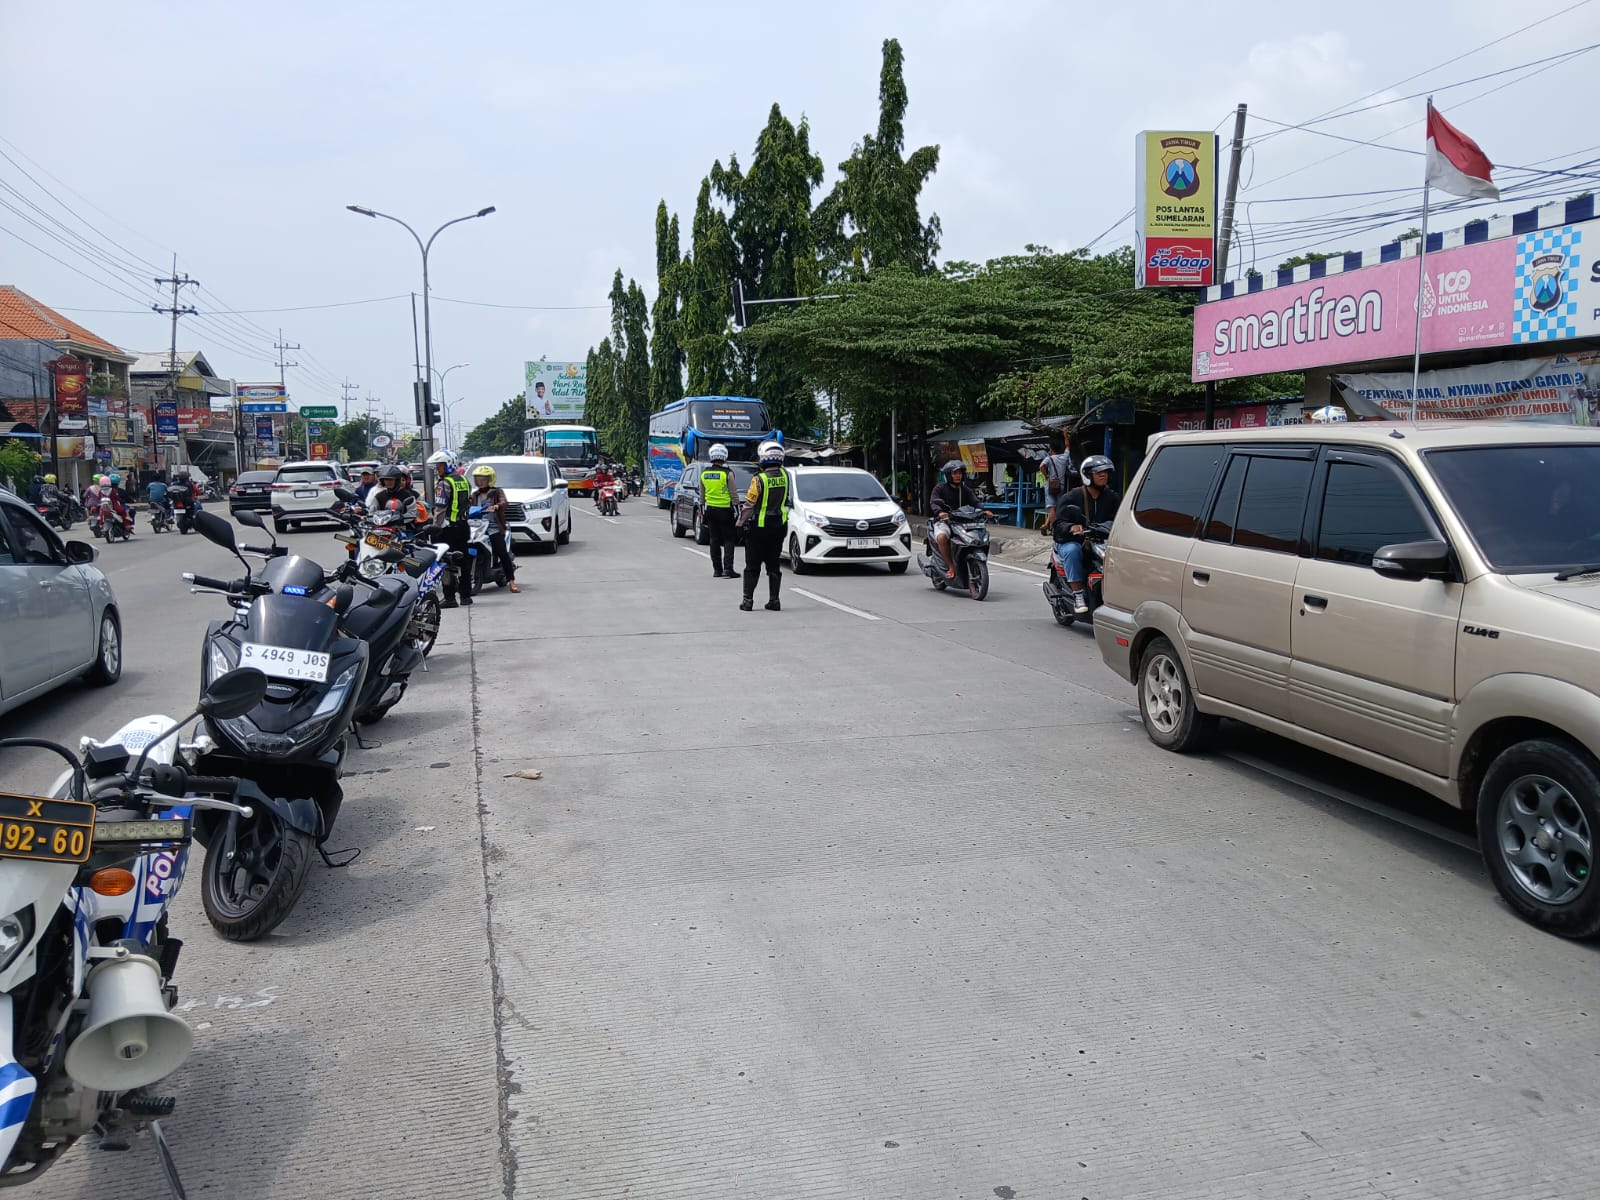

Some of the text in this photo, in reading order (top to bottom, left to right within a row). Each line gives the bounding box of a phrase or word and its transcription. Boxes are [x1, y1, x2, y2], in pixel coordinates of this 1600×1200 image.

[1155, 214, 1205, 222] SUMELARAN
[1174, 206, 1205, 214] LANTAS
[1148, 255, 1211, 271] Sedaap
[1436, 269, 1472, 296] 100
[1438, 291, 1470, 305] UNTUK
[1437, 299, 1489, 316] INDONESIA
[1213, 287, 1382, 356] smartfren
[1358, 389, 1405, 400] PENTING
[1447, 382, 1493, 397] NYAWA
[1495, 378, 1533, 394] ATAU
[1535, 373, 1571, 388] GAYA
[1574, 371, 1585, 385] ?
[1440, 397, 1475, 409] BELUM
[1477, 391, 1520, 406] CUKUP
[1521, 388, 1558, 400] UMUR
[711, 421, 752, 430] PATAS
[703, 473, 721, 481] POLISI
[245, 645, 253, 657] S
[261, 648, 295, 663] 4949
[27, 800, 43, 817] X
